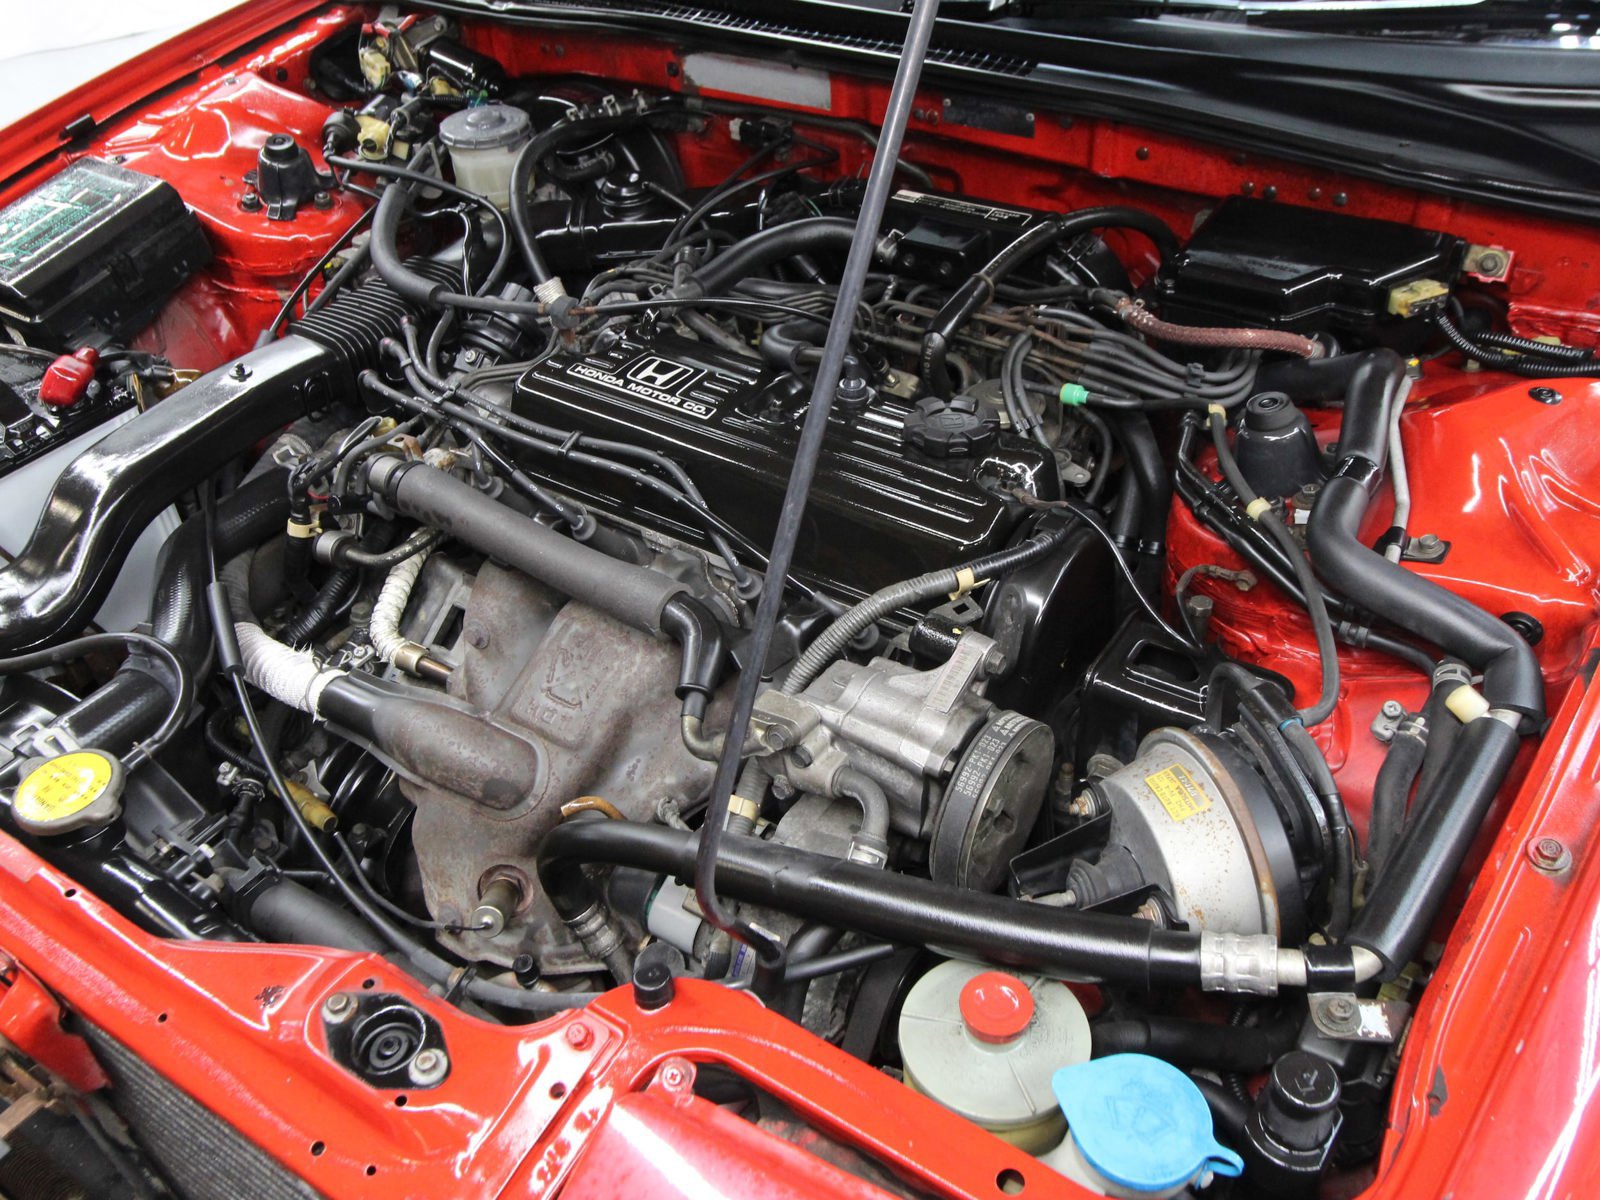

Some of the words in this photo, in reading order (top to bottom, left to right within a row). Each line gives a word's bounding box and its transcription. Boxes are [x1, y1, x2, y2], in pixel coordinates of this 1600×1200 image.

[574, 365, 624, 387] HONDA
[627, 382, 681, 405] MOTOR
[683, 401, 707, 415] CO.
